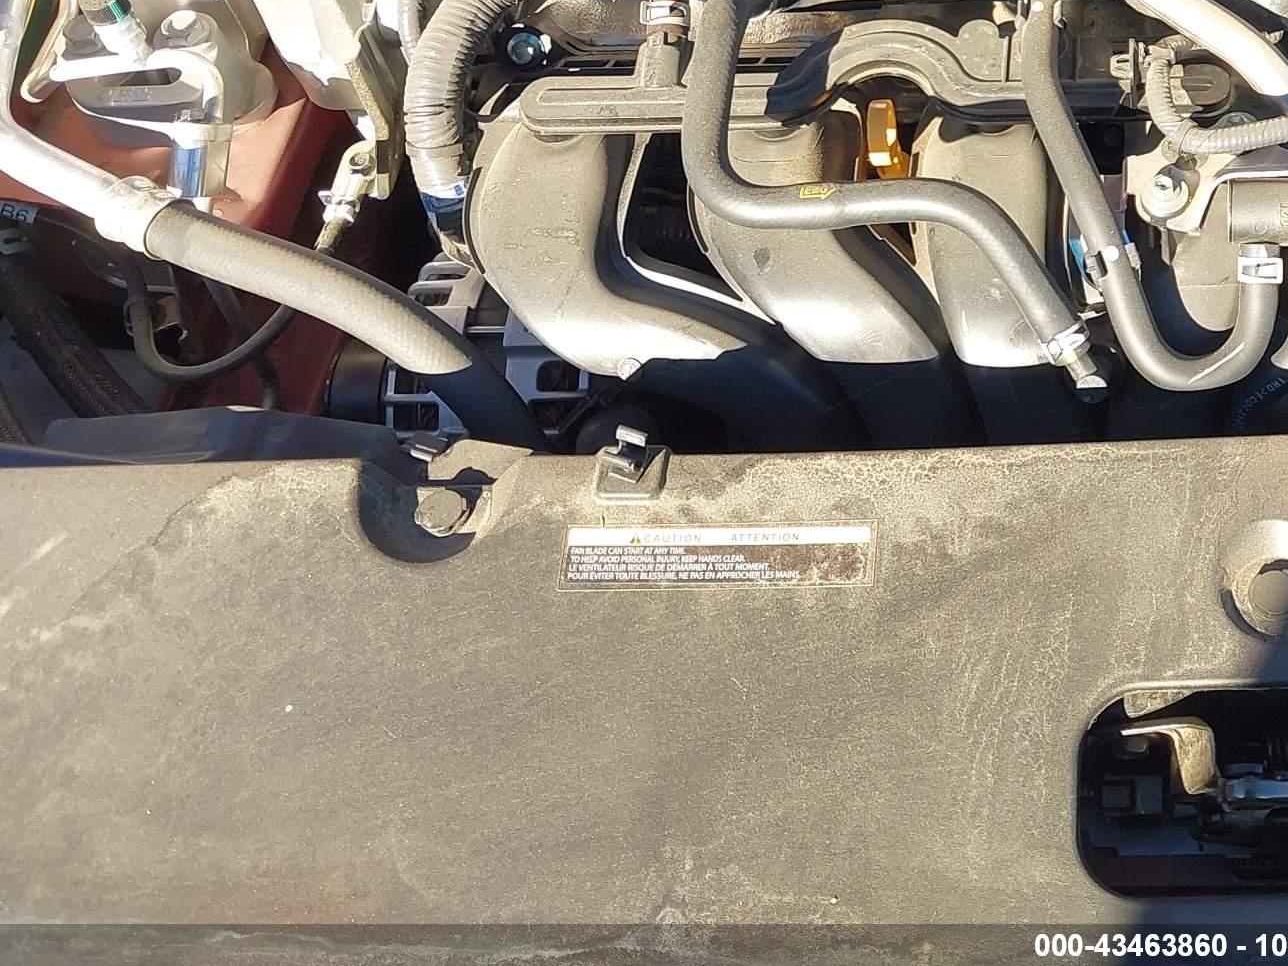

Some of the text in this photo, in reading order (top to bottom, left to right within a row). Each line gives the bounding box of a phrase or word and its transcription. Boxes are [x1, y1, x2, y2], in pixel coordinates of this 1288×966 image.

[643, 532, 800, 543] CAUTION ATTENTION
[681, 554, 697, 562] KEEP
[698, 554, 722, 562] HANDS
[569, 563, 578, 571] LE
[578, 563, 627, 571] VENTILATEUR
[628, 563, 655, 571] RISQUE
[655, 563, 666, 571] DE
[714, 563, 734, 571] TOUT
[568, 572, 590, 580] POUR
[614, 572, 640, 580] TOUTE
[690, 571, 704, 579] PAS
[705, 571, 716, 579] EN
[716, 571, 761, 579] APPROCHER
[761, 571, 775, 579] LES
